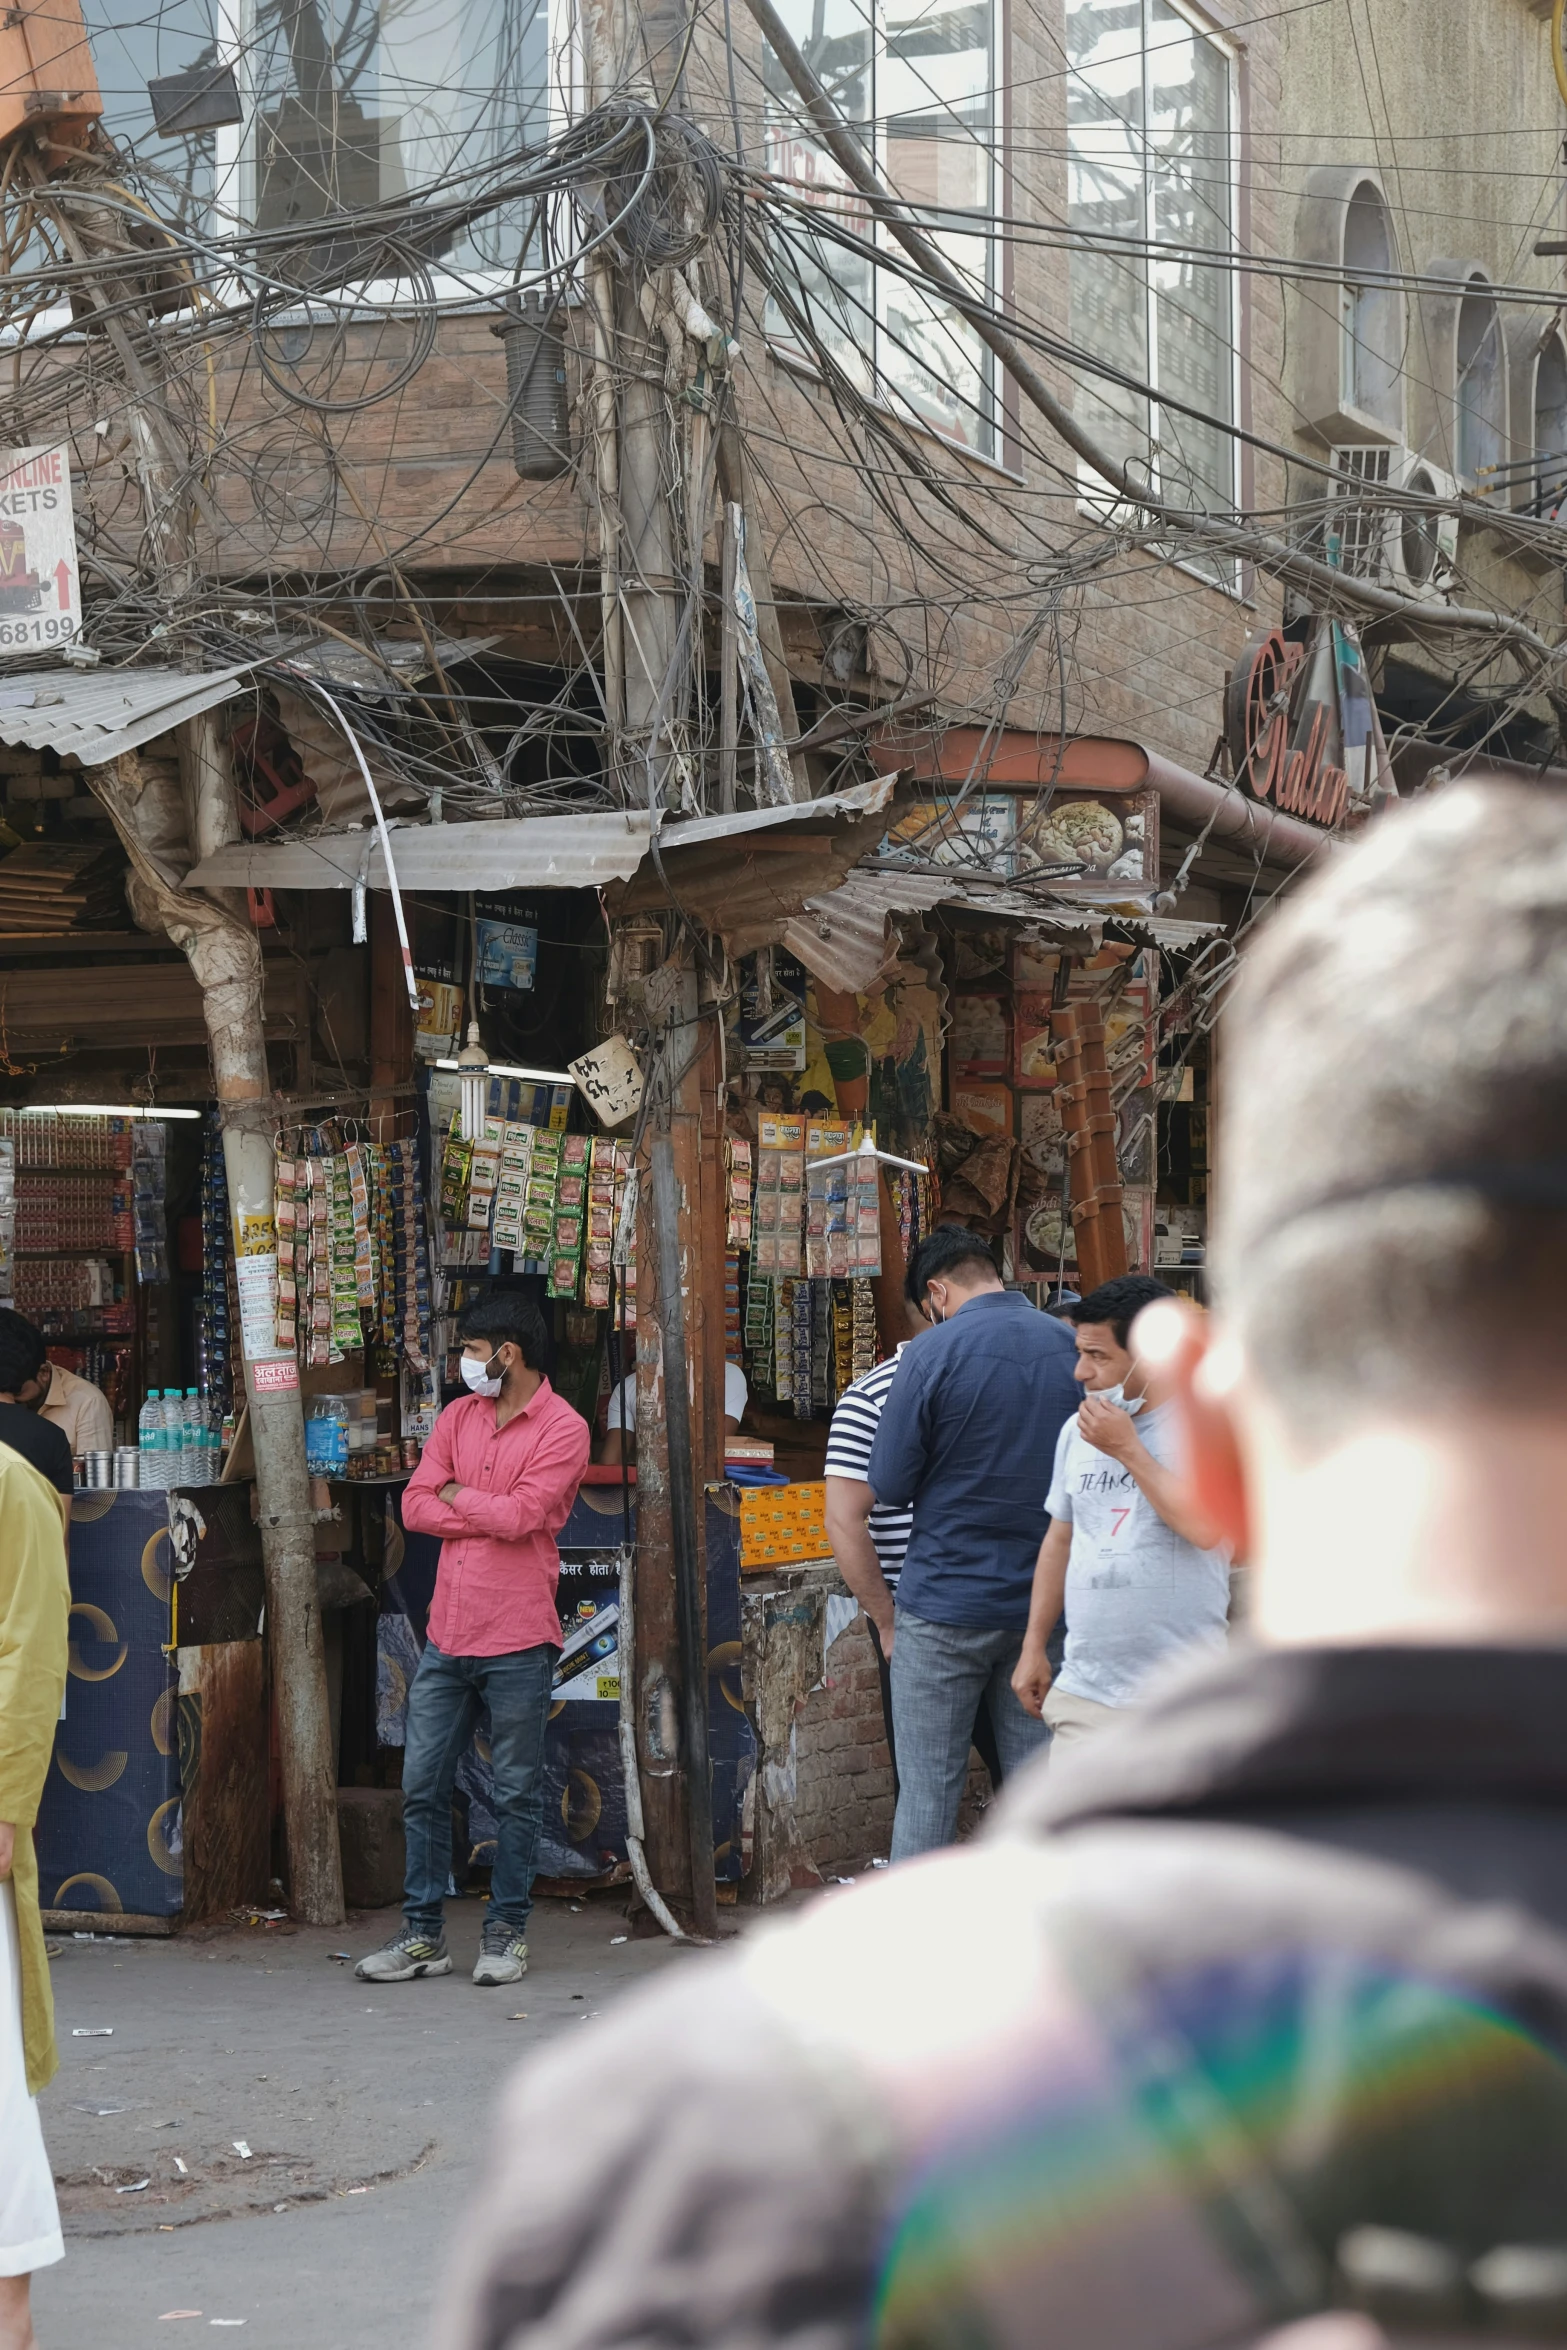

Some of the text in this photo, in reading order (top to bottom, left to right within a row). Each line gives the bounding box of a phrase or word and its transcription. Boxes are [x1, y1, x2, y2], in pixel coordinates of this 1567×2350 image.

[0, 616, 75, 646] 68199
[503, 927, 532, 948] Classic
[410, 1424, 429, 1432] HANS
[1111, 1507, 1131, 1537] 7
[559, 1560, 583, 1576] कैंसर
[589, 1560, 609, 1576] होता
[579, 1605, 595, 1613] NEW
[599, 1690, 609, 1698] 10
